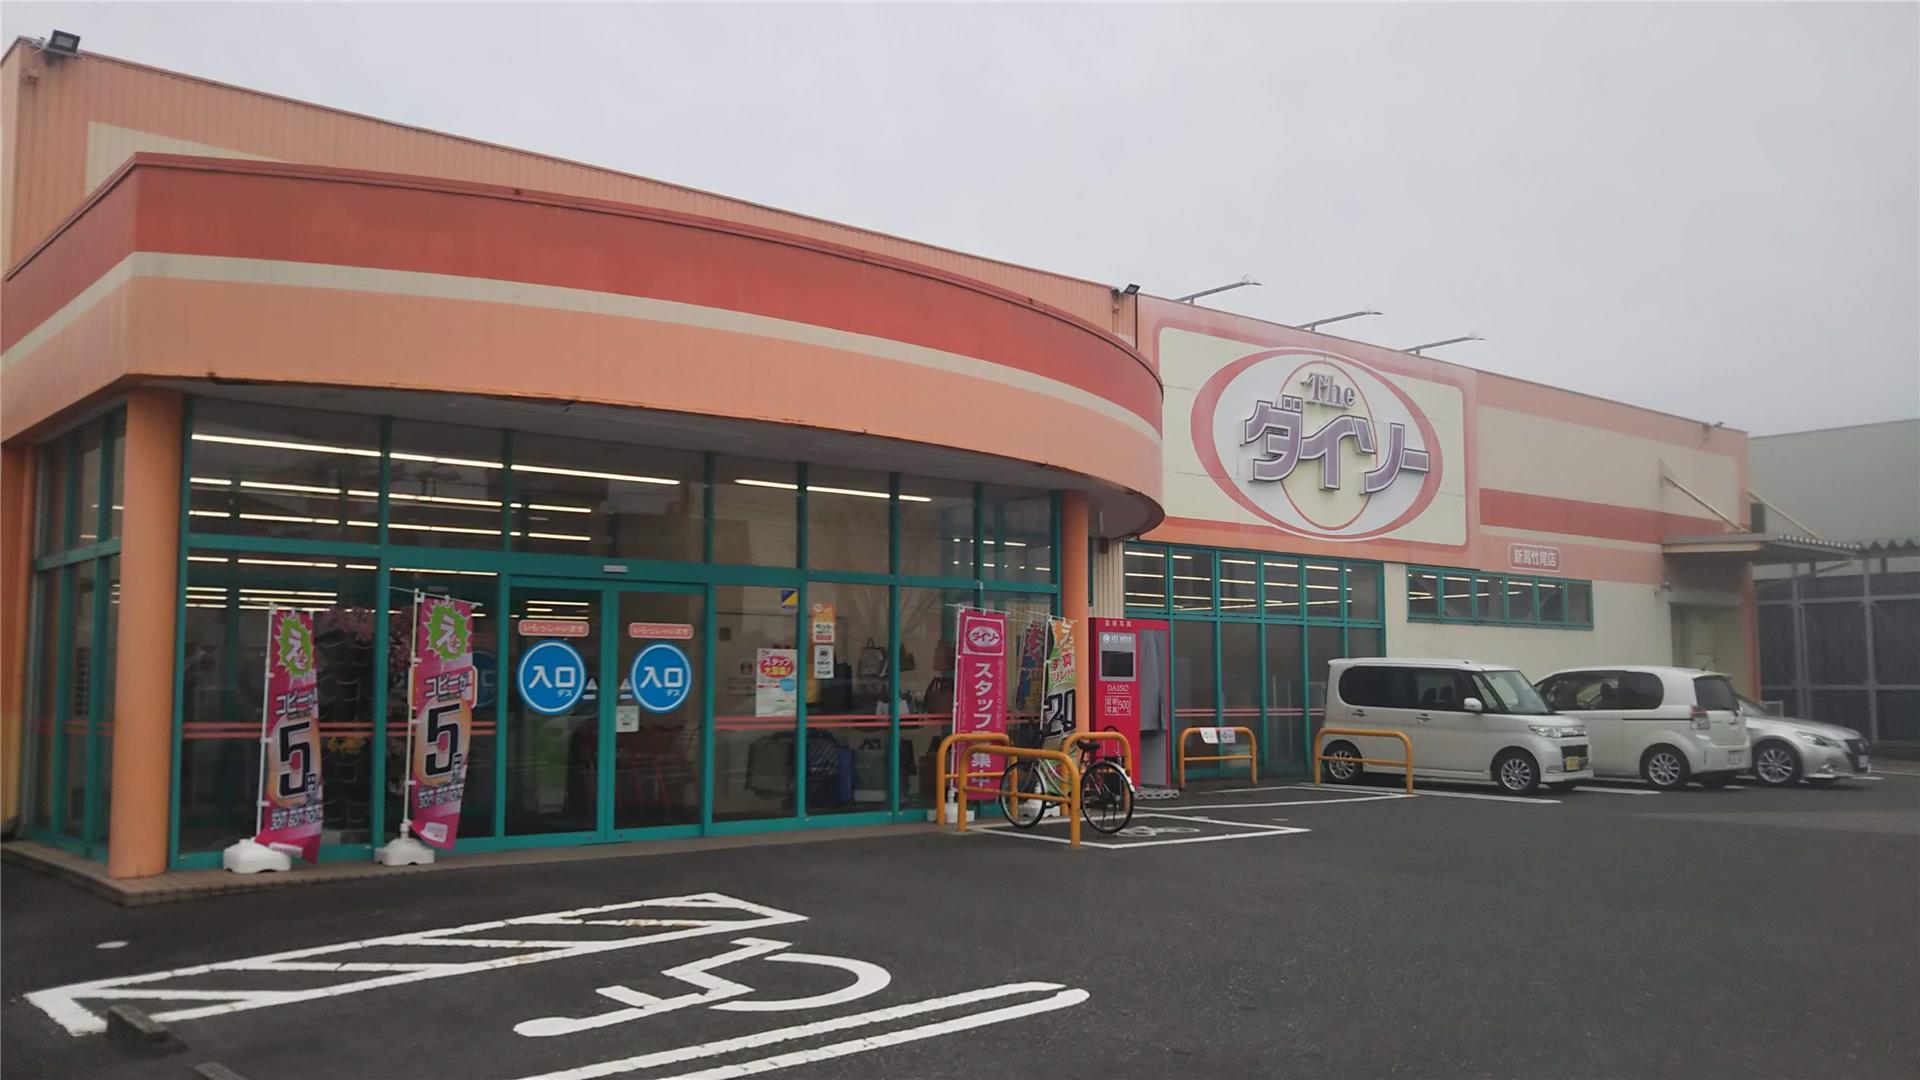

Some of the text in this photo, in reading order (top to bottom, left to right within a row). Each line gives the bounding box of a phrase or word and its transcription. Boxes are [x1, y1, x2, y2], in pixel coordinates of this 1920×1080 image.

[1302, 373, 1356, 408] The
[1244, 394, 1430, 494] ダイソー
[528, 665, 576, 689] 入口
[639, 665, 683, 689] 入口
[1107, 684, 1129, 692] DAISO
